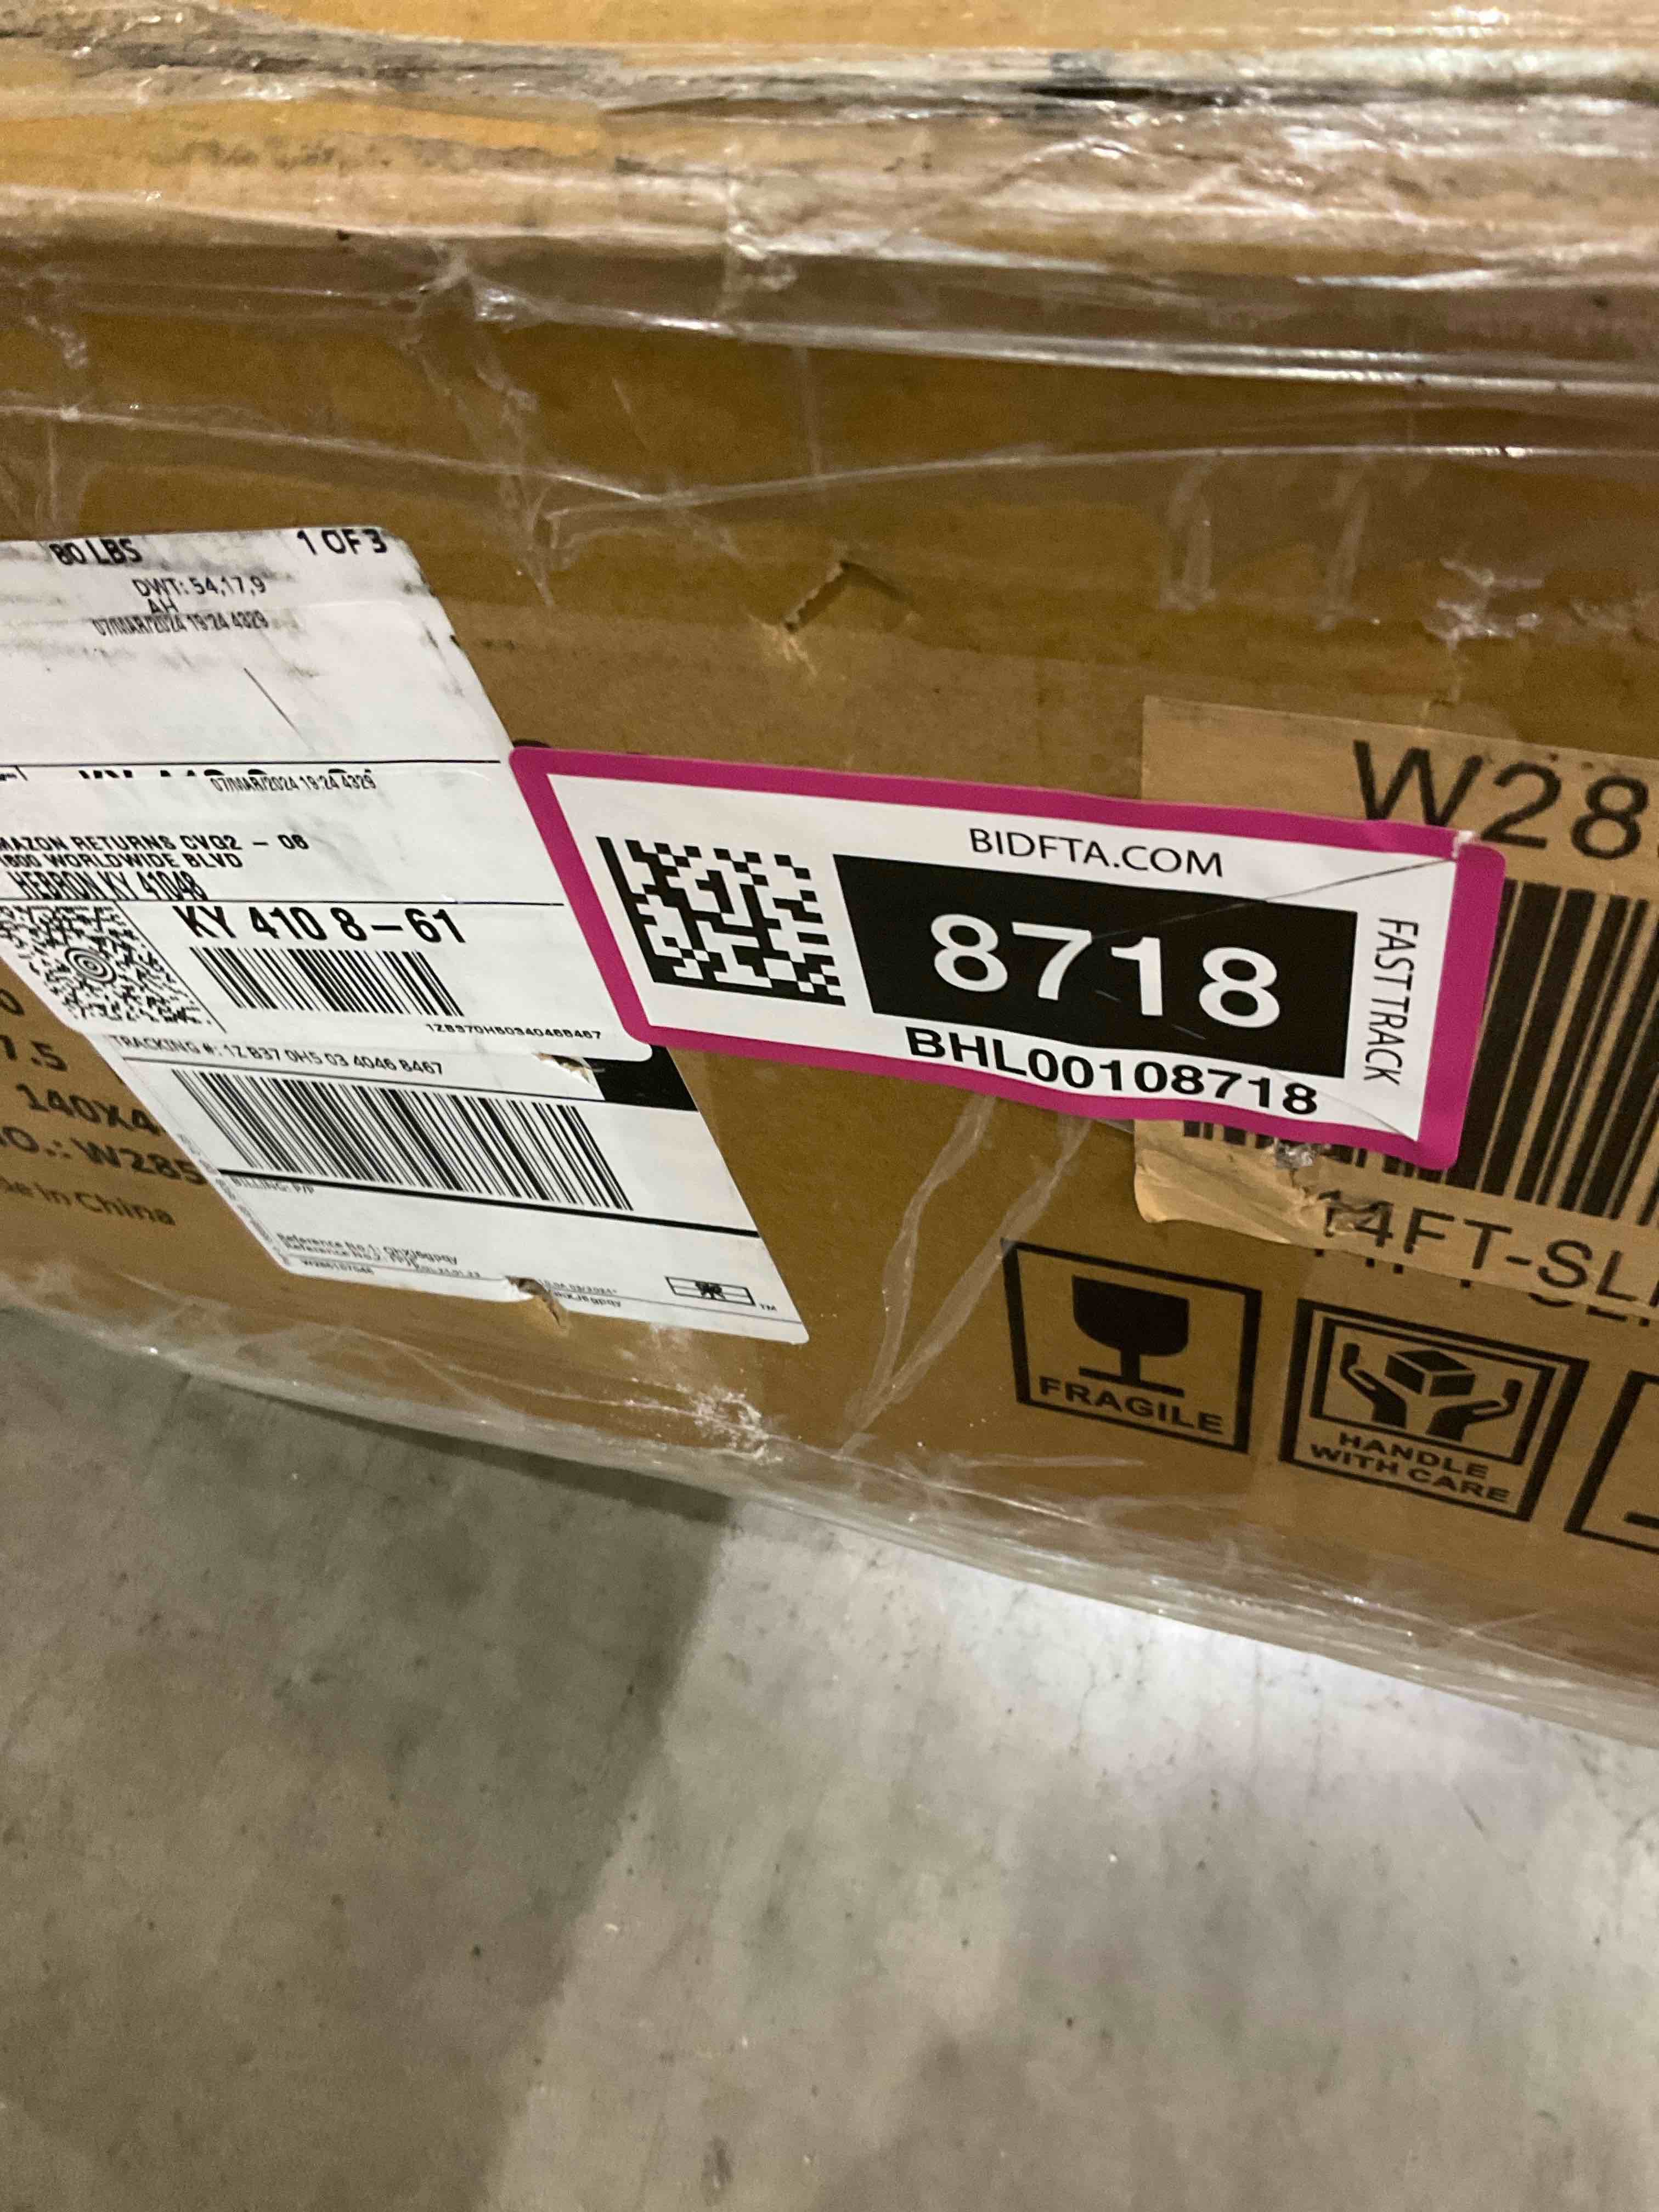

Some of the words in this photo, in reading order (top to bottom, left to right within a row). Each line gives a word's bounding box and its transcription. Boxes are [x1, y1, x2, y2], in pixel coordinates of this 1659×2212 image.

[48, 543, 88, 565] 80
[85, 538, 143, 565] LBS
[297, 529, 318, 556] 1
[321, 529, 362, 555] OF
[362, 528, 387, 554] 3
[132, 577, 189, 597] DWT:
[188, 575, 267, 596] 54,17,9
[341, 774, 377, 790] 4329
[1353, 740, 1659, 860] W28
[42, 853, 180, 867] WORLDWIDE
[182, 853, 243, 867] BLVD
[69, 835, 177, 850] RETURNS
[969, 827, 1223, 878] BIDFTA.COM
[6, 870, 109, 900] HEBRON
[97, 870, 139, 900] KY
[172, 905, 237, 939] KY
[248, 906, 328, 941] 410
[930, 913, 1281, 1029] 8718
[1373, 917, 1419, 991] FAST
[108, 1034, 202, 1054] TRACKING
[223, 1043, 249, 1059] 1Z
[246, 1046, 281, 1062] B37
[324, 1052, 349, 1067] 03
[353, 1053, 397, 1072] 4046
[398, 1058, 443, 1075] 8467
[1363, 996, 1410, 1087] TRACK
[905, 1025, 1318, 1116] BHL00108718
[74, 1192, 177, 1226] China
[1318, 1189, 1659, 1308] 14FT-SL
[1039, 1375, 1224, 1435] FRAGILE
[1310, 1443, 1399, 1475] WITH
[1407, 1468, 1511, 1503] CARE
[1339, 1431, 1489, 1480] HANDLE
